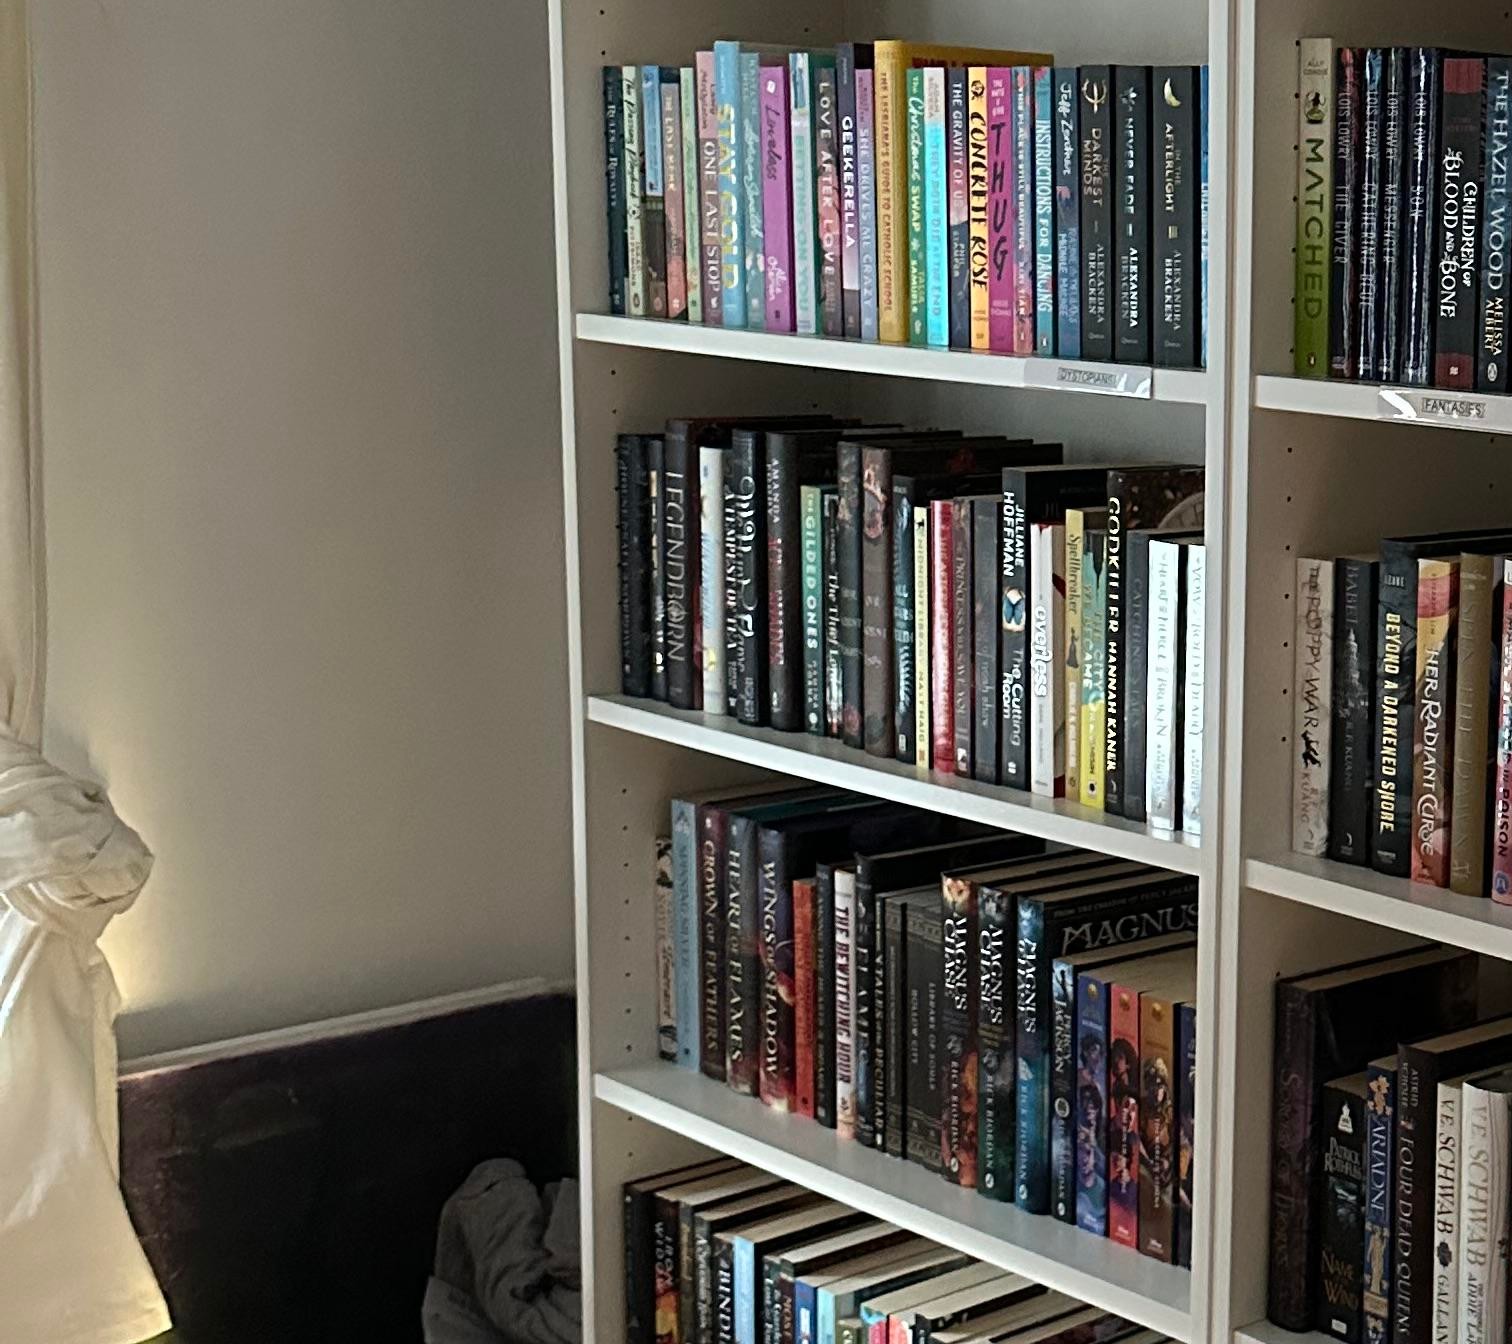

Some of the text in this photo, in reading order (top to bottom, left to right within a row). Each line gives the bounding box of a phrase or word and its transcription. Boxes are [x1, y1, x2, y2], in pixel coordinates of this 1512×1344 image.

[716, 104, 739, 289] STAY GOLD
[841, 116, 855, 248] GEEKERELLA
[970, 112, 988, 292] CONCRETE ROSE
[1035, 120, 1051, 313] INSTRUCTIONS DANCING
[1302, 138, 1327, 321] MATCHED
[1486, 69, 1511, 291] THE HAZEL WOOD
[662, 471, 688, 662] LEGENDBORN
[1002, 491, 1015, 577] HOFFMAN
[1014, 504, 1024, 568] JILLIANE
[1067, 533, 1081, 616] Spellbreaker
[1378, 612, 1402, 833] BEYOND A DARKENED SHORE
[762, 861, 778, 1079] WINGS SHADOW
